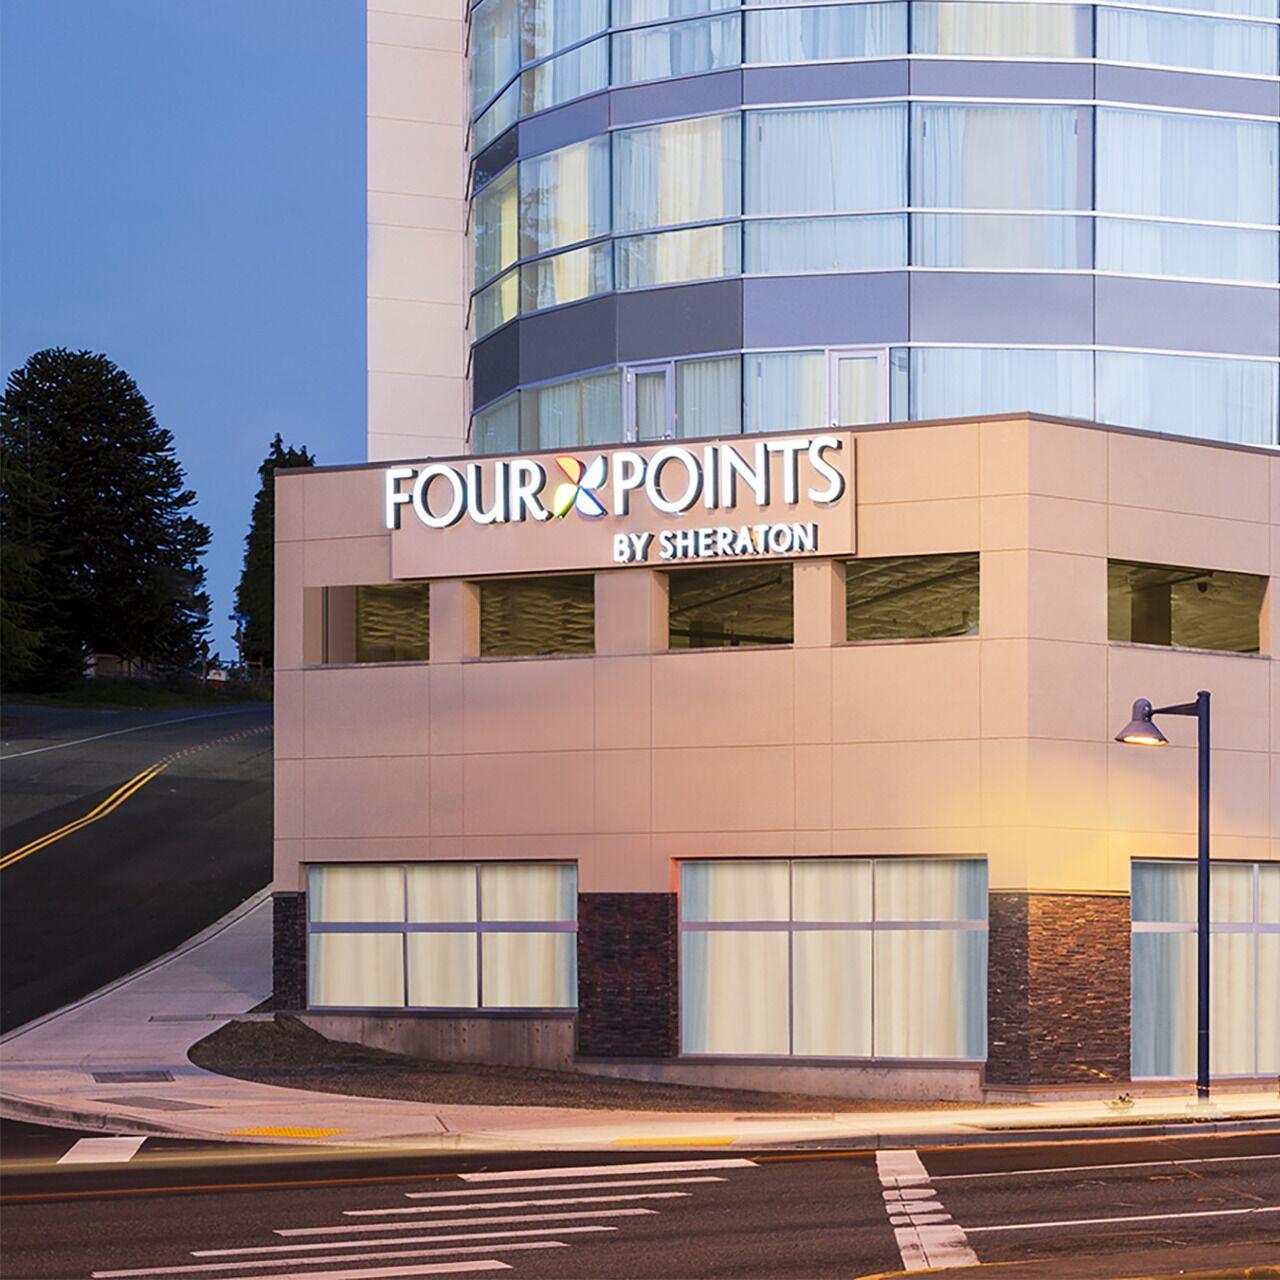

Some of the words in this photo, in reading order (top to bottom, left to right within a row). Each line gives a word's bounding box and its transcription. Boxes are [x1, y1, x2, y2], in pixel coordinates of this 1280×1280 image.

[385, 459, 552, 529] FOUR
[612, 435, 846, 515] POINTS
[613, 530, 652, 563] BY
[658, 522, 819, 560] SHERATON
